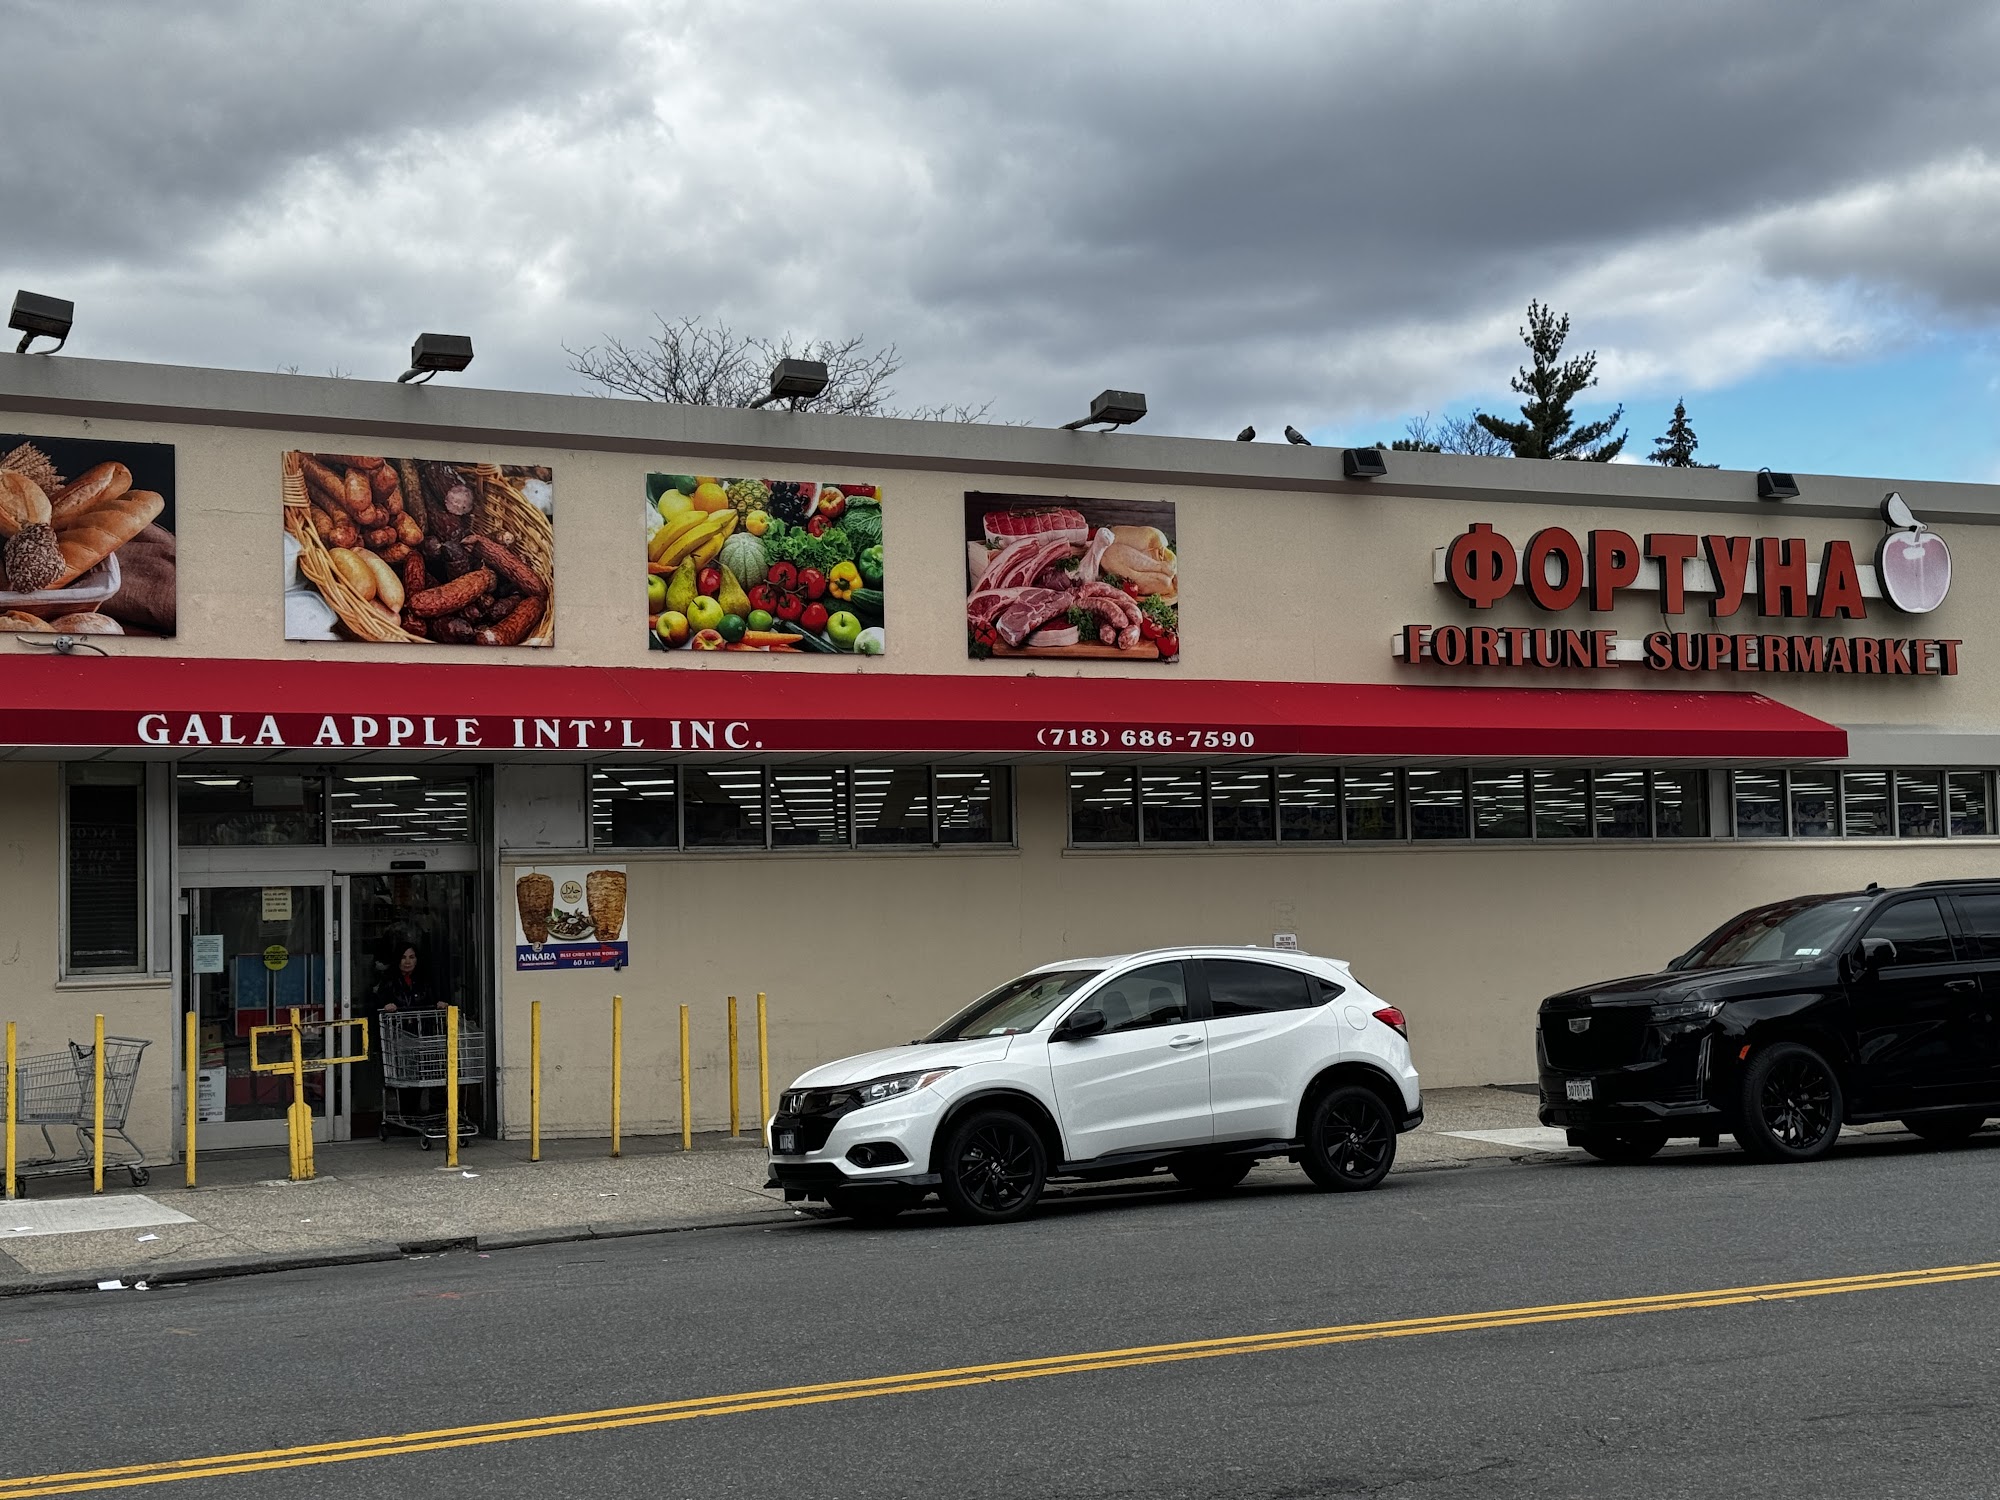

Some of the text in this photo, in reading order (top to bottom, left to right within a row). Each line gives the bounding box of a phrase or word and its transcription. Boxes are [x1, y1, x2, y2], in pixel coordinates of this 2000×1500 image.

[1445, 523, 1868, 620] ФОРТУНА
[1402, 624, 1963, 676] FORTUNE SUPERMARKET
[136, 713, 763, 749] GALA APPLE INT'L INC.
[1036, 728, 1255, 748] (718) 686-7590
[518, 952, 557, 962] ANKARA
